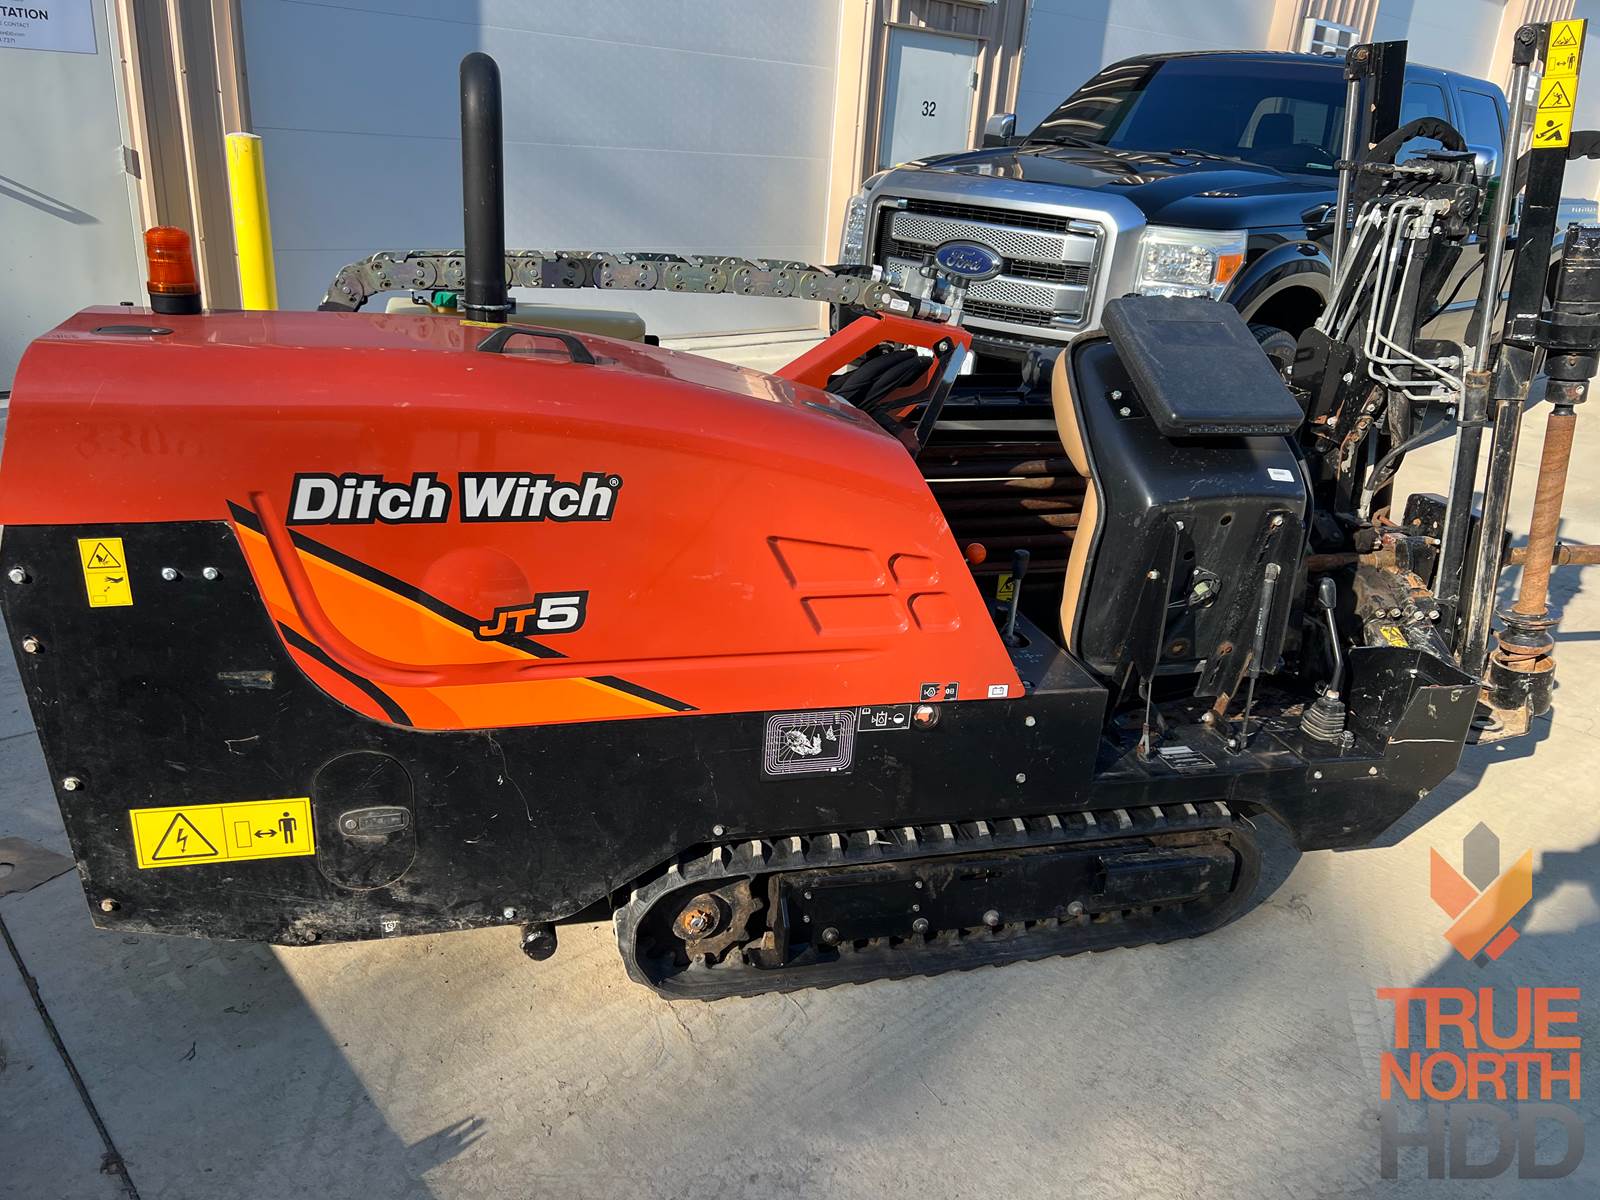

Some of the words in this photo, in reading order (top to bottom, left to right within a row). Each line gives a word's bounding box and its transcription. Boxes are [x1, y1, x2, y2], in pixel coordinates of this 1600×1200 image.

[921, 100, 937, 117] 32
[292, 477, 447, 520] Ditch
[479, 596, 580, 637] JT5
